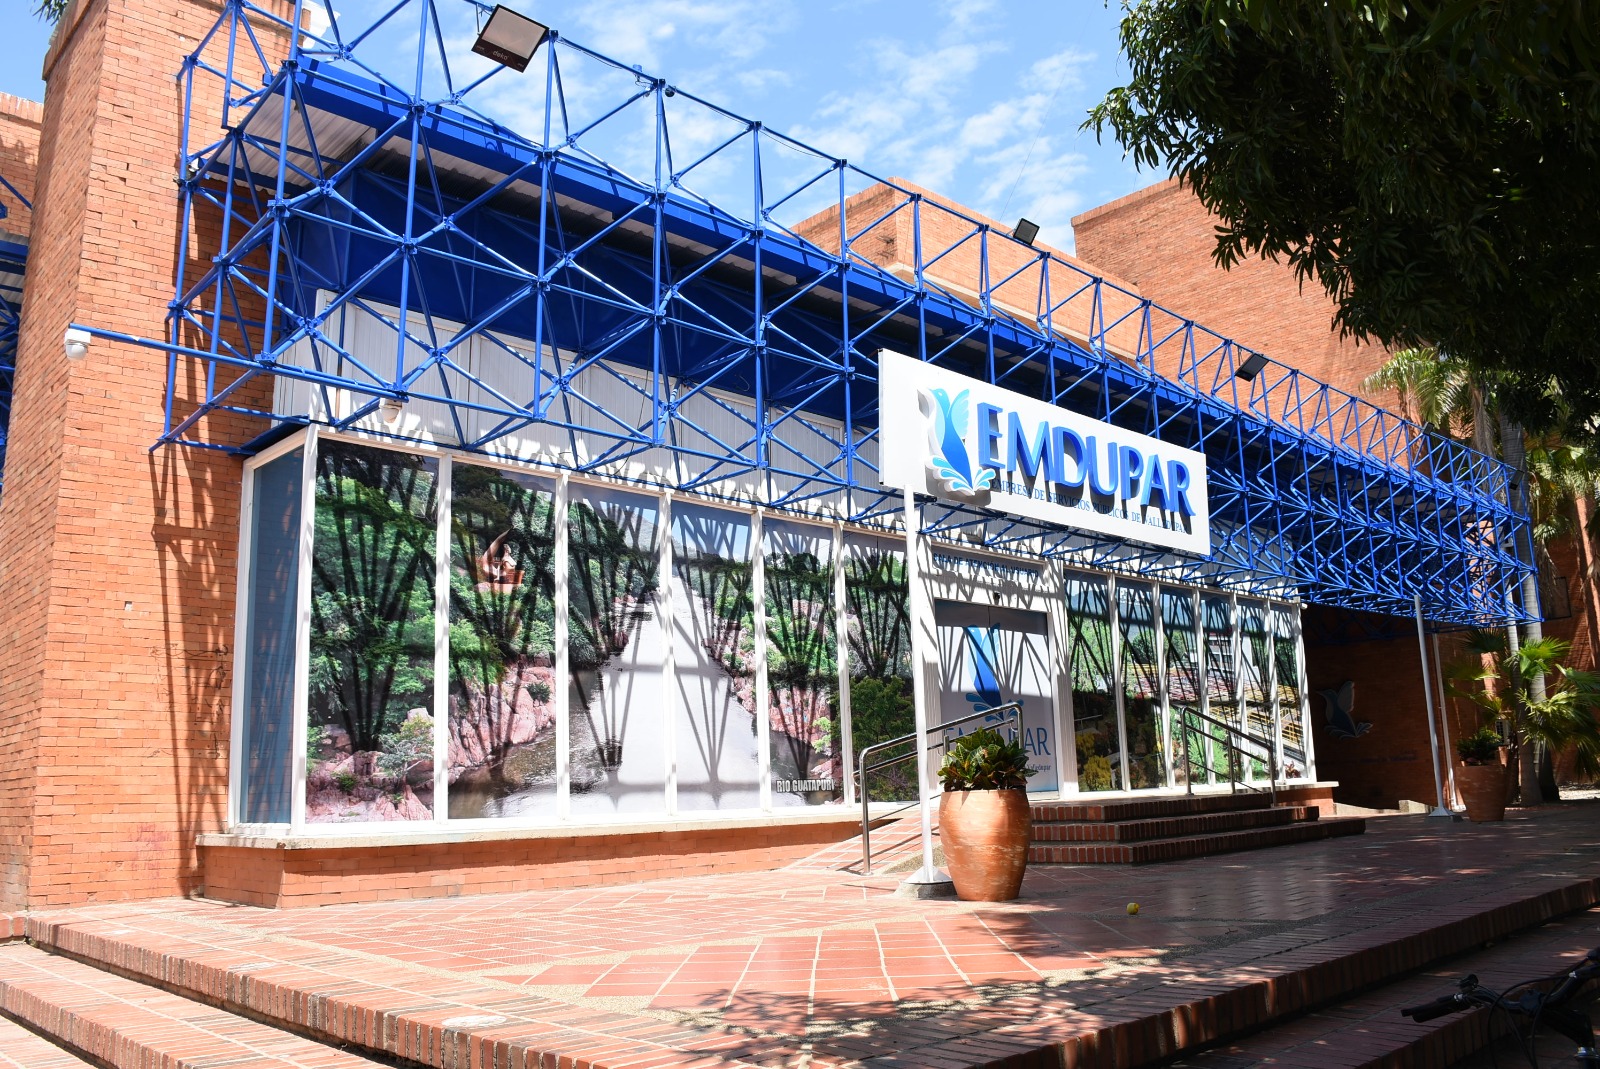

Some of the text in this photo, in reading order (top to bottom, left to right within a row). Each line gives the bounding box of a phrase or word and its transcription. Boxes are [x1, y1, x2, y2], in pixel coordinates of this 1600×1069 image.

[977, 402, 1196, 516] EMDUPAR
[991, 478, 1032, 498] EMPRESA
[1034, 488, 1045, 501] DE
[1048, 492, 1091, 512] SERVICIOS
[1131, 511, 1141, 523] DE
[933, 553, 951, 563] SALA
[954, 556, 964, 565] DE
[776, 780, 791, 793] RIO
